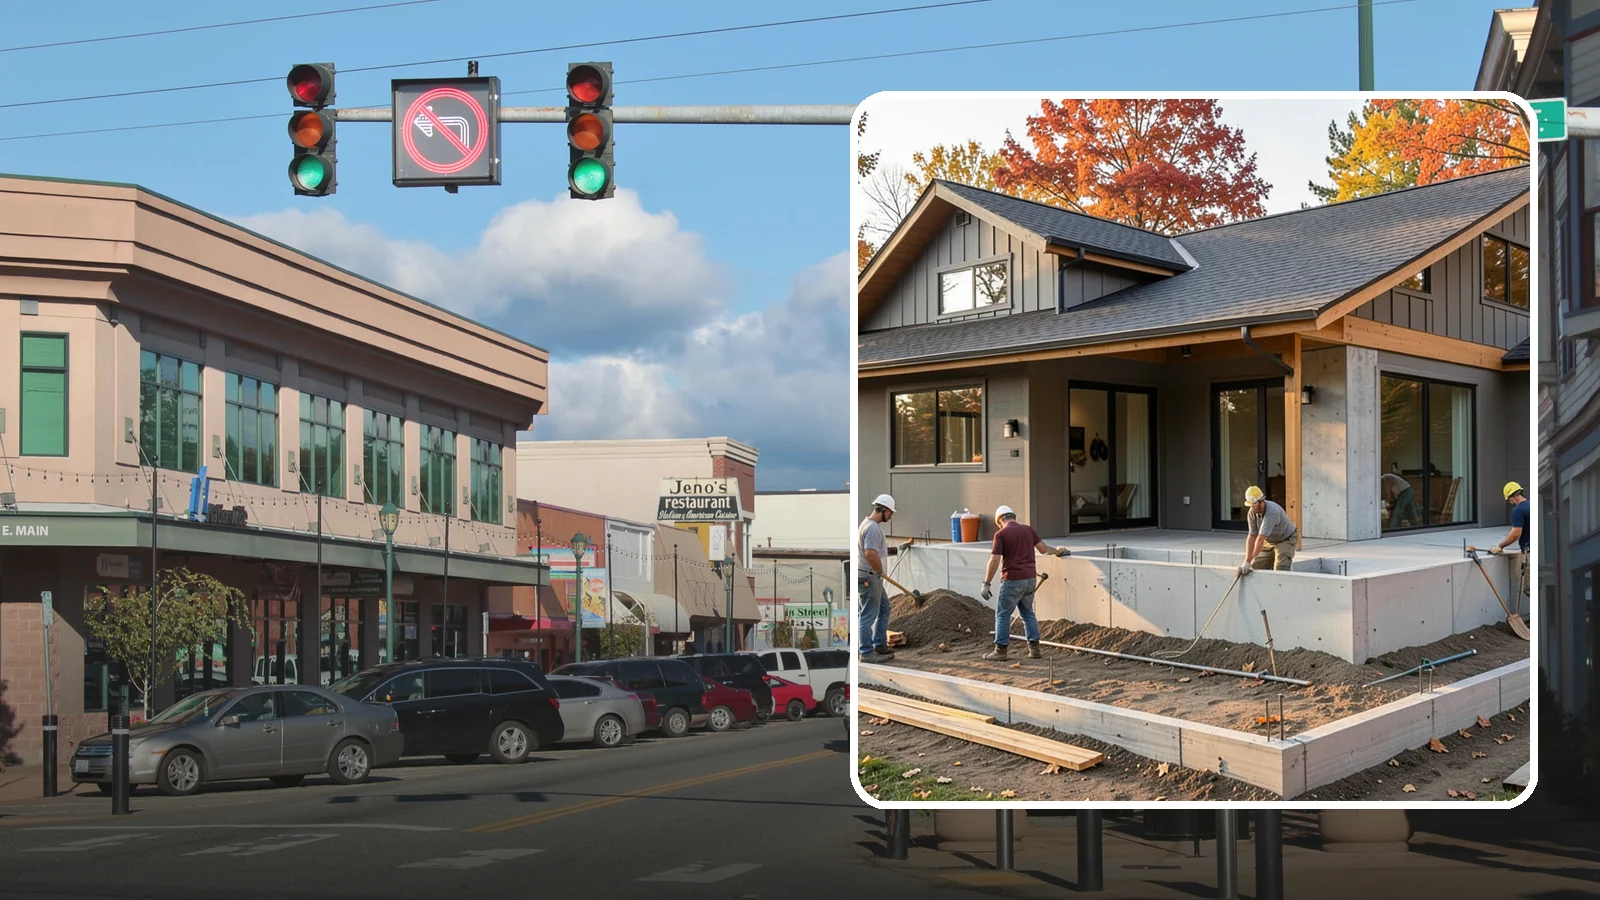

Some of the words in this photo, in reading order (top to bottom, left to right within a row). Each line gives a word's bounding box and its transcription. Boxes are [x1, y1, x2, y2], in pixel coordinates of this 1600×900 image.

[669, 480, 727, 494] Jeno's
[665, 496, 731, 509] restaurant
[658, 509, 681, 519] Italian
[686, 509, 714, 519] American
[715, 509, 738, 519] Cuisine
[2, 525, 13, 536] E.
[15, 525, 49, 536] MAIN
[797, 607, 829, 617] Street
